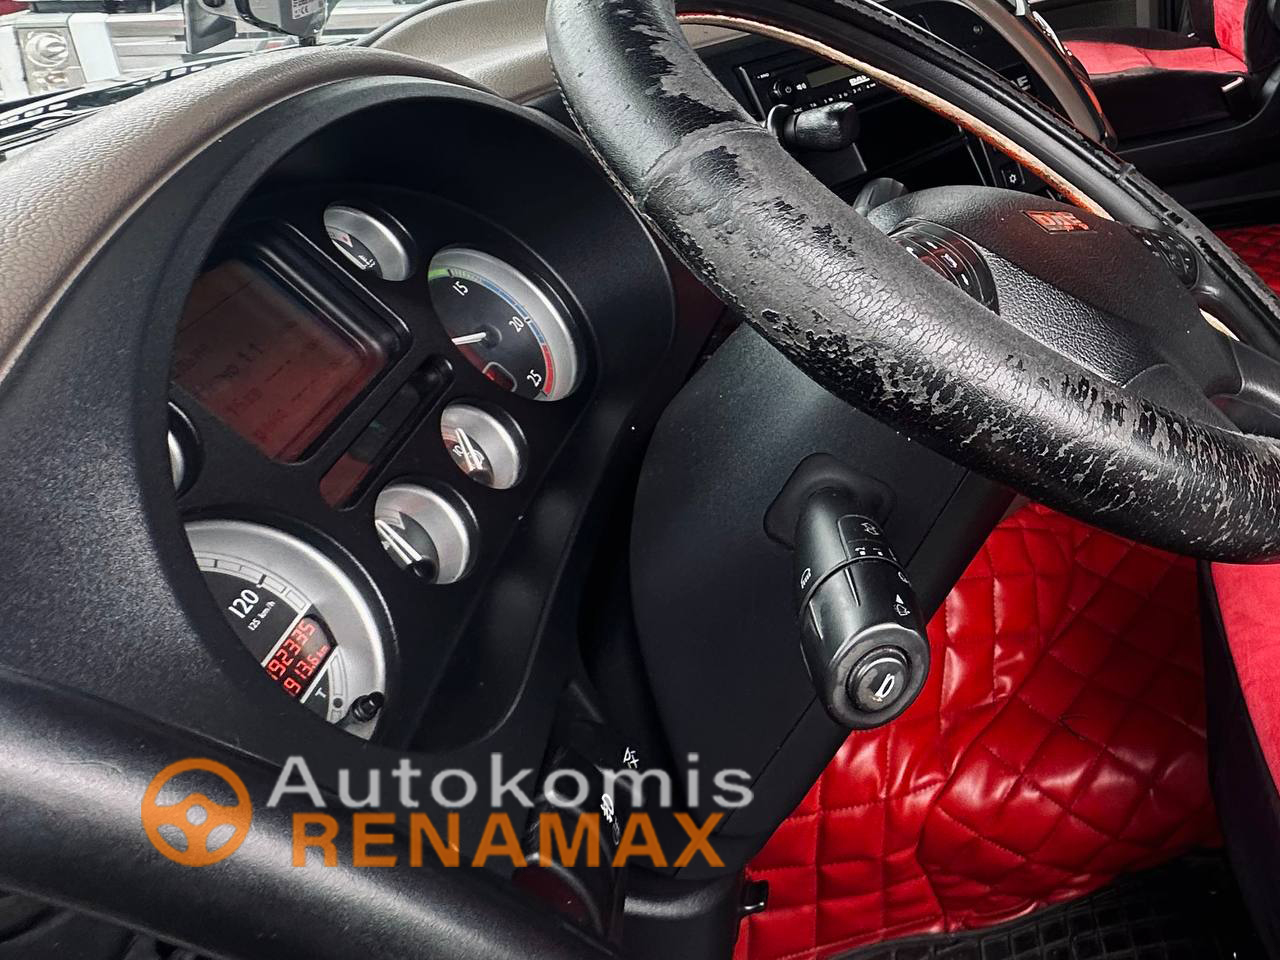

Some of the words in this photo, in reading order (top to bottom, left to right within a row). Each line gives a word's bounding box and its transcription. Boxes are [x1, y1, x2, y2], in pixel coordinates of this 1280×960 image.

[452, 281, 469, 296] 15
[508, 316, 524, 333] 20
[526, 369, 542, 387] 25
[228, 589, 260, 619] 120
[247, 618, 262, 631] 125
[257, 601, 276, 619] km/h
